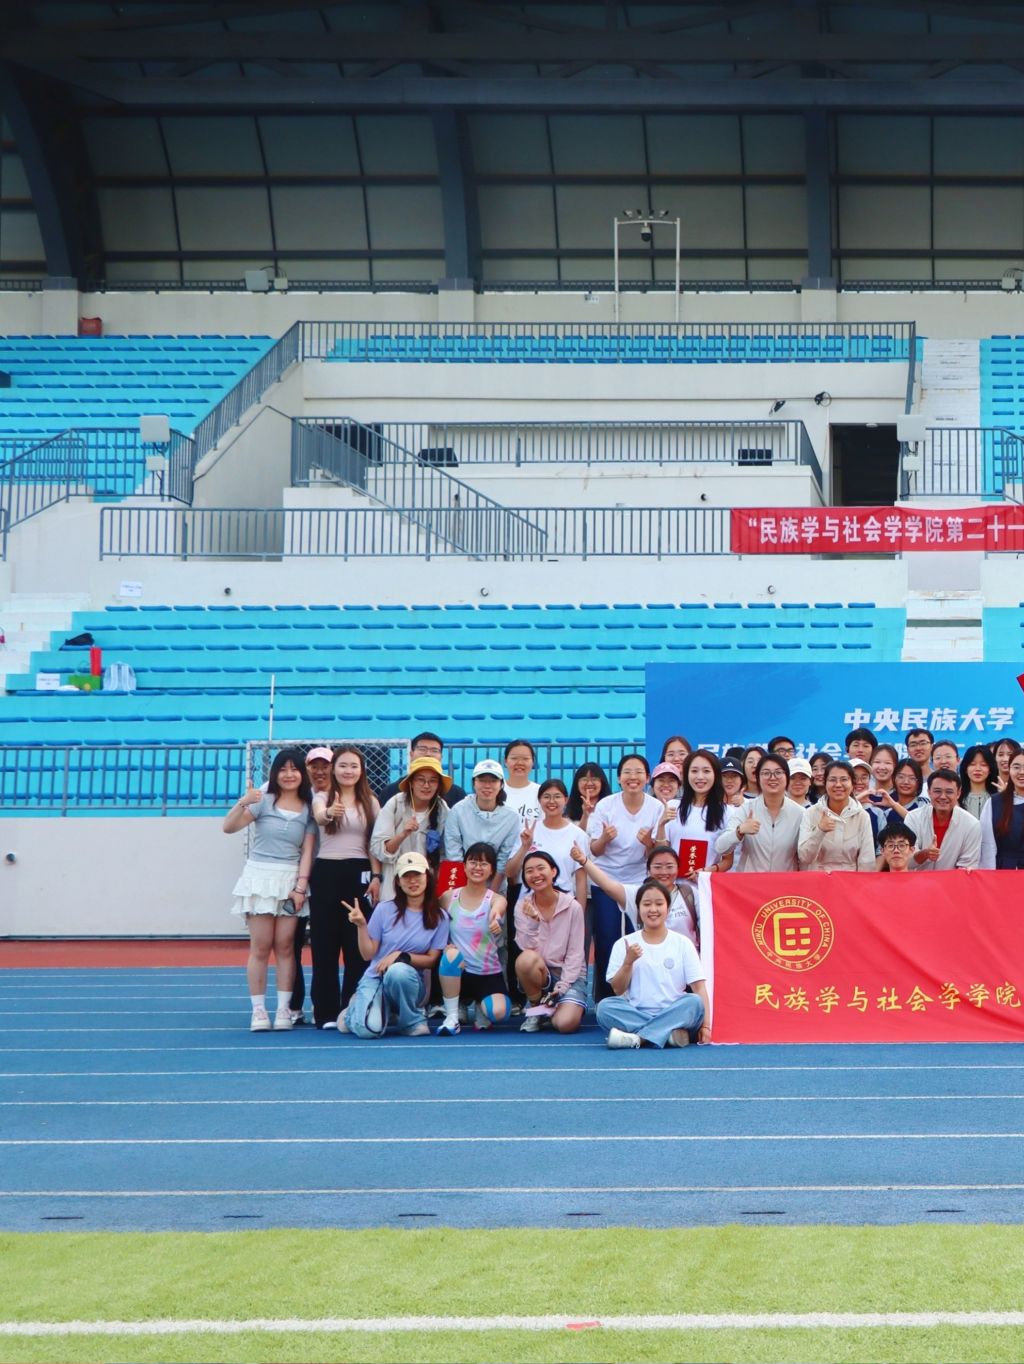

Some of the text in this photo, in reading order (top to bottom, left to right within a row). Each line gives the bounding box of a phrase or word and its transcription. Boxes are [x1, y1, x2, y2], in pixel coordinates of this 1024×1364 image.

[843, 707, 1015, 732] 中央民族大学
[755, 898, 831, 948] MINZU UNIVERSITY OF CHINA
[754, 981, 1022, 1014] 民族学与社会学学院
